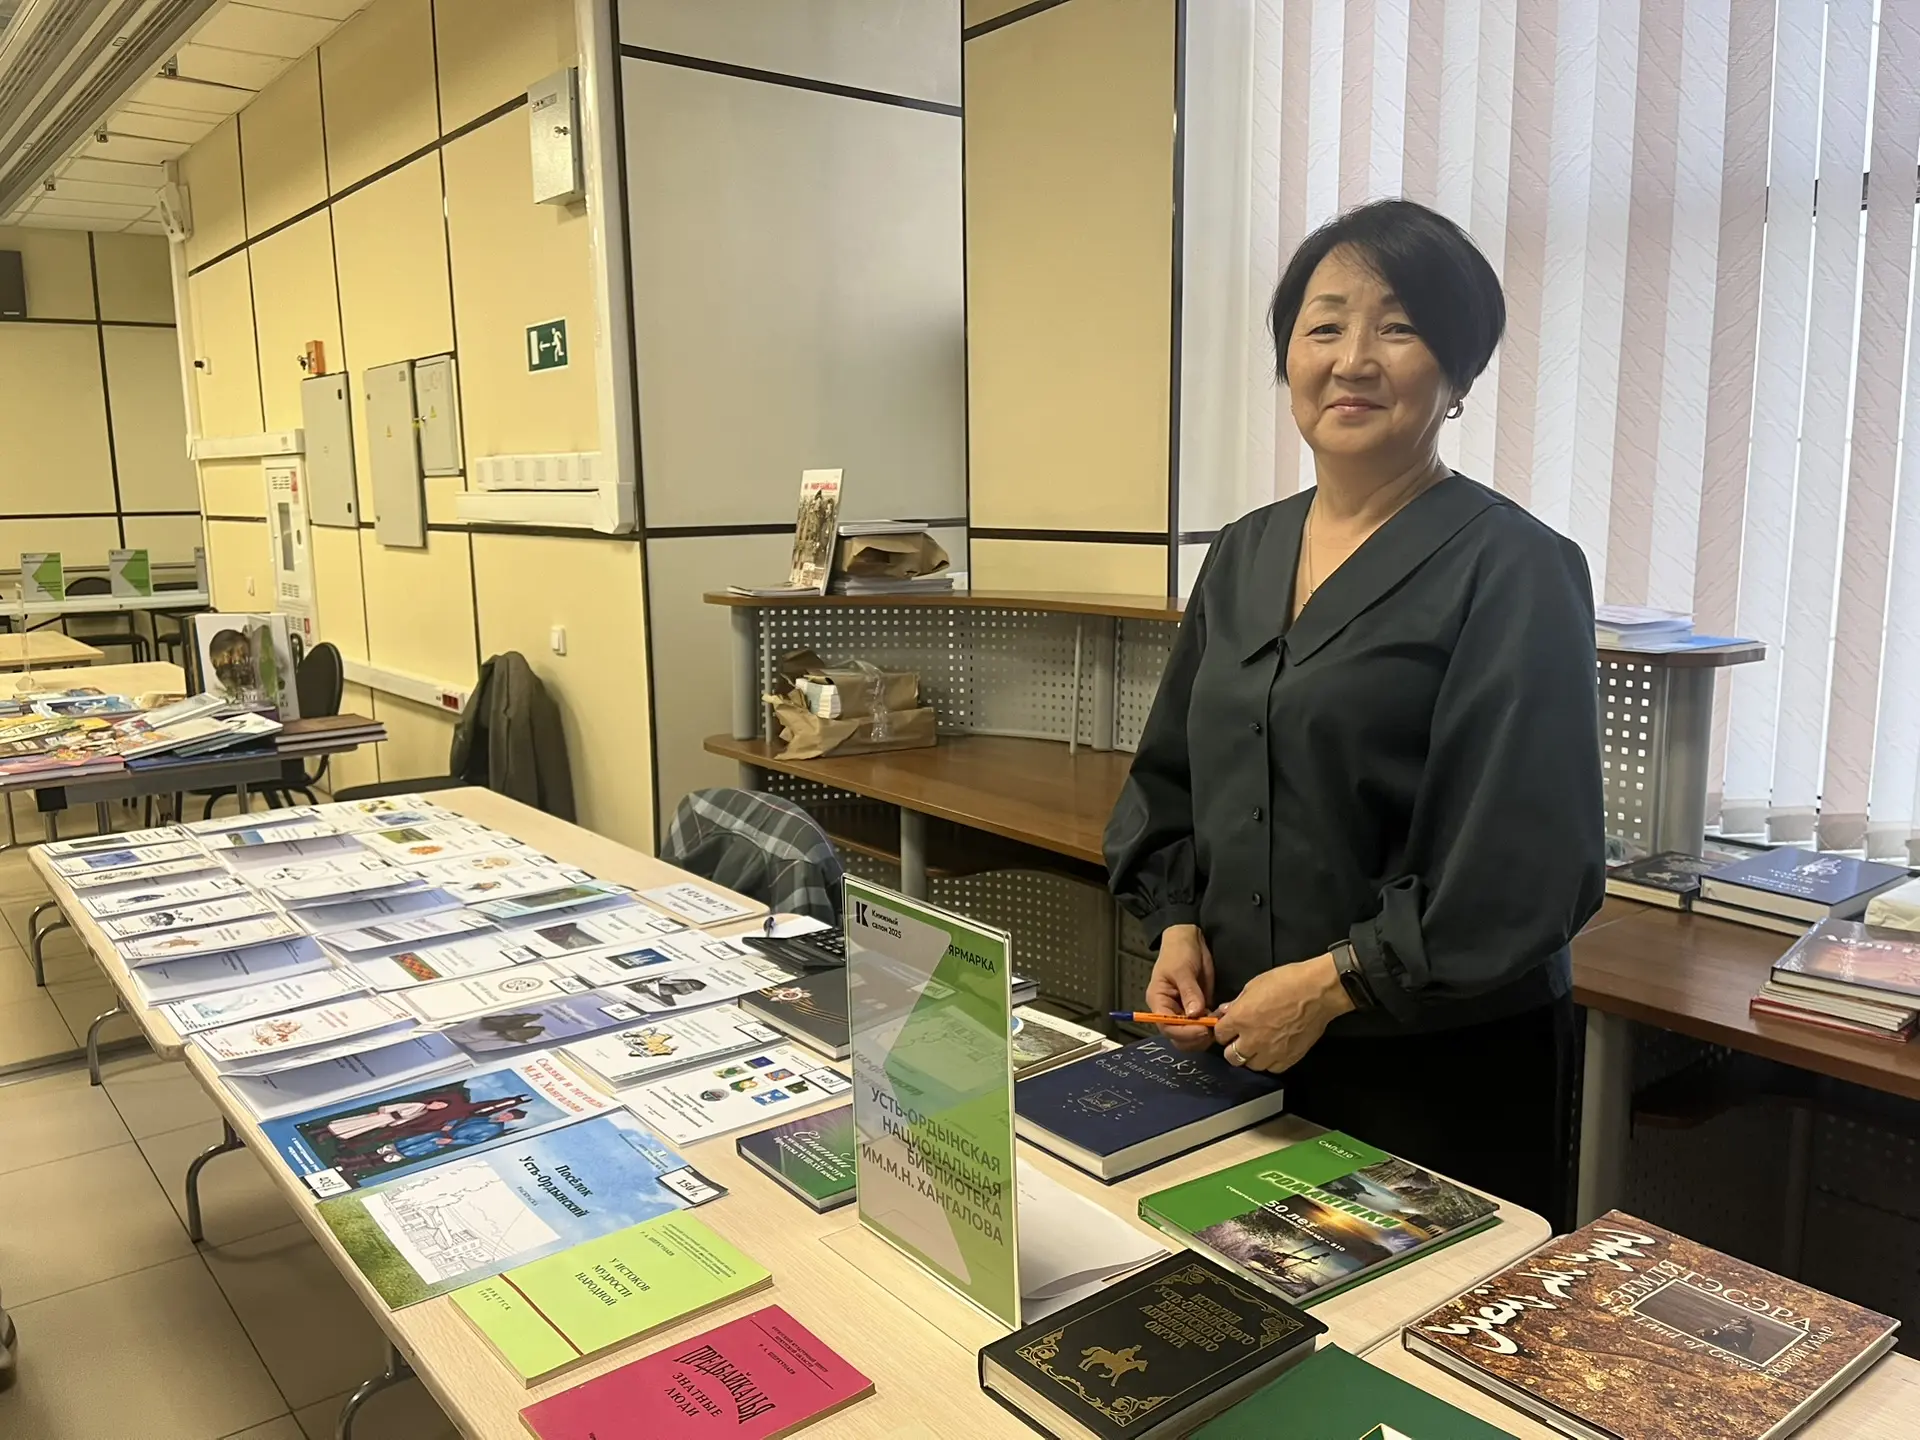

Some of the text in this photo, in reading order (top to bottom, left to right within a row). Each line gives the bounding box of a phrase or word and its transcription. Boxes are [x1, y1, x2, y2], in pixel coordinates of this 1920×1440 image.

[872, 909, 899, 925] Книжный
[872, 921, 902, 939] салон 2025
[948, 944, 996, 974] ЯРМАРКА
[522, 1064, 584, 1113] М.Н. Хангалова
[536, 1058, 567, 1082] Сказки
[570, 1087, 608, 1109] легенды
[871, 1086, 1001, 1176] УСТЬ-ОРДЫНСКАЯ
[882, 1115, 1002, 1201] НАЦИОНАЛЬНАЯ
[519, 1155, 591, 1219] Усть-Ордынский
[555, 1164, 594, 1198] Посёлок
[906, 1147, 1003, 1221] БИБЛИОТЕКА
[1260, 1171, 1402, 1229] РОМАНТИКИ
[917, 1176, 1004, 1246] ХАНГАЛОВА
[1264, 1200, 1319, 1231] 50 лет
[575, 1271, 618, 1307] НАРОДНОЙ
[592, 1264, 633, 1299] МУДРОСТИ
[614, 1262, 651, 1293] ИСТОКОВ
[1609, 1259, 1686, 1306] ЗЕМЛЯ
[1681, 1270, 1812, 1333] ГЭСЭРА
[484, 1287, 512, 1311] ИРКУТСК
[1154, 1285, 1256, 1345] УСТЬ-ОРДЫНСКОГО
[1189, 1293, 1244, 1324] ИСТОРИЯ
[1138, 1304, 1219, 1352] АВТОНОМНОГО
[1144, 1320, 1188, 1348] ОКРУГА
[1156, 1300, 1227, 1342] БУРЯТСКОГО
[1633, 1317, 1682, 1339] Land
[1684, 1340, 1706, 1349] of
[1802, 1325, 1834, 1357] ГАЗАР
[664, 1387, 701, 1418] ЛЮДИ
[672, 1372, 723, 1418] ЗНАТНЫЕ
[673, 1344, 776, 1425] ПРЕДБАЙКАЛЬЯ
